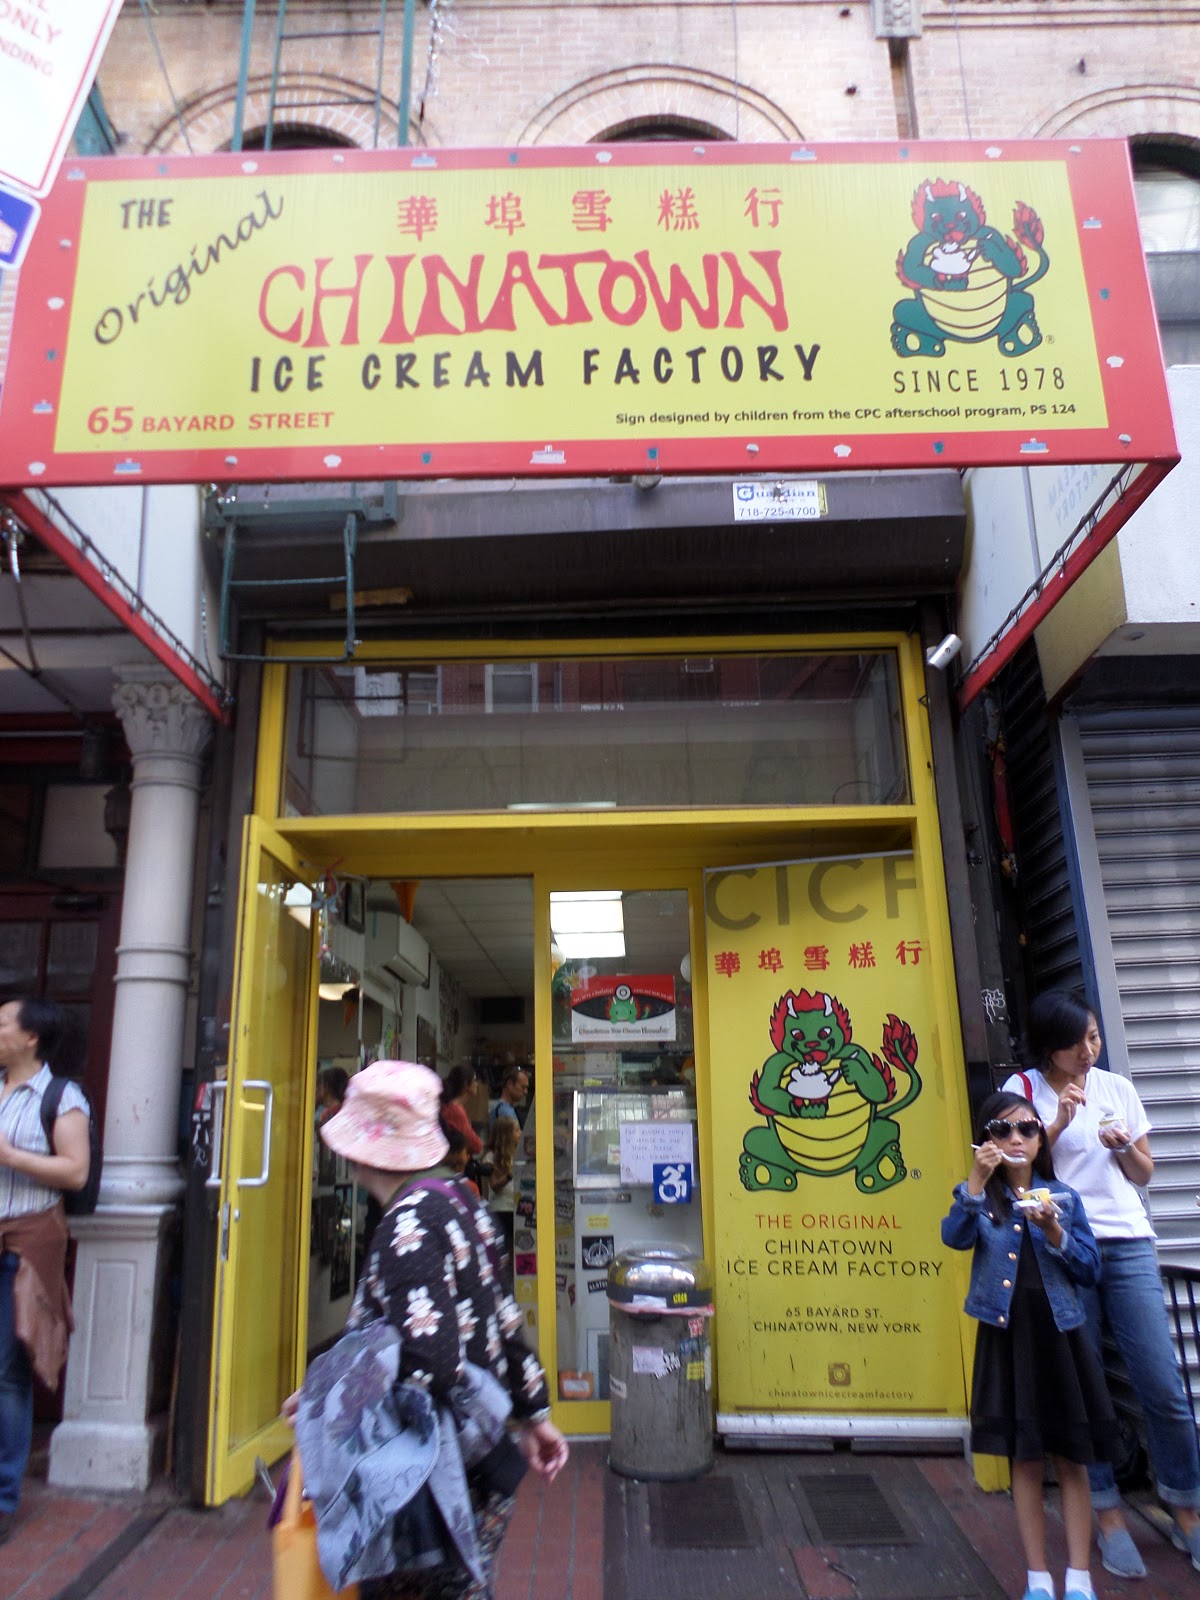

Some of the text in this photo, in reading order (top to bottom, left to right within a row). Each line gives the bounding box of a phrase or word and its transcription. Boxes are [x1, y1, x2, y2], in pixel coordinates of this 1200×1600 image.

[121, 199, 174, 230] THE
[397, 186, 783, 241] 華埠雪糕行
[94, 190, 284, 346] Original
[258, 250, 789, 349] CHINATOWN
[250, 343, 821, 393] ICE CREAM FACTORY
[893, 366, 1066, 394] SINCE 1978
[87, 406, 335, 434] 65 BAYARD STREET
[616, 403, 1076, 426] Sign designed by children from the CPC afterschool program, PS 124
[737, 485, 815, 501] Guadian
[739, 506, 816, 517] 718-725-4700
[705, 856, 917, 931] CICF
[714, 940, 923, 978] 華埠雪糕行
[755, 1214, 902, 1229] THE ORIGINAL
[765, 1239, 892, 1255] CHINATOWN
[727, 1260, 943, 1276] ICE CREAM FACTORY
[786, 1307, 883, 1318] 65 BAYARD ST.
[754, 1322, 921, 1334] CHINATOWN, NEW YORK
[768, 1389, 914, 1400] chinatownicecreamfactory
